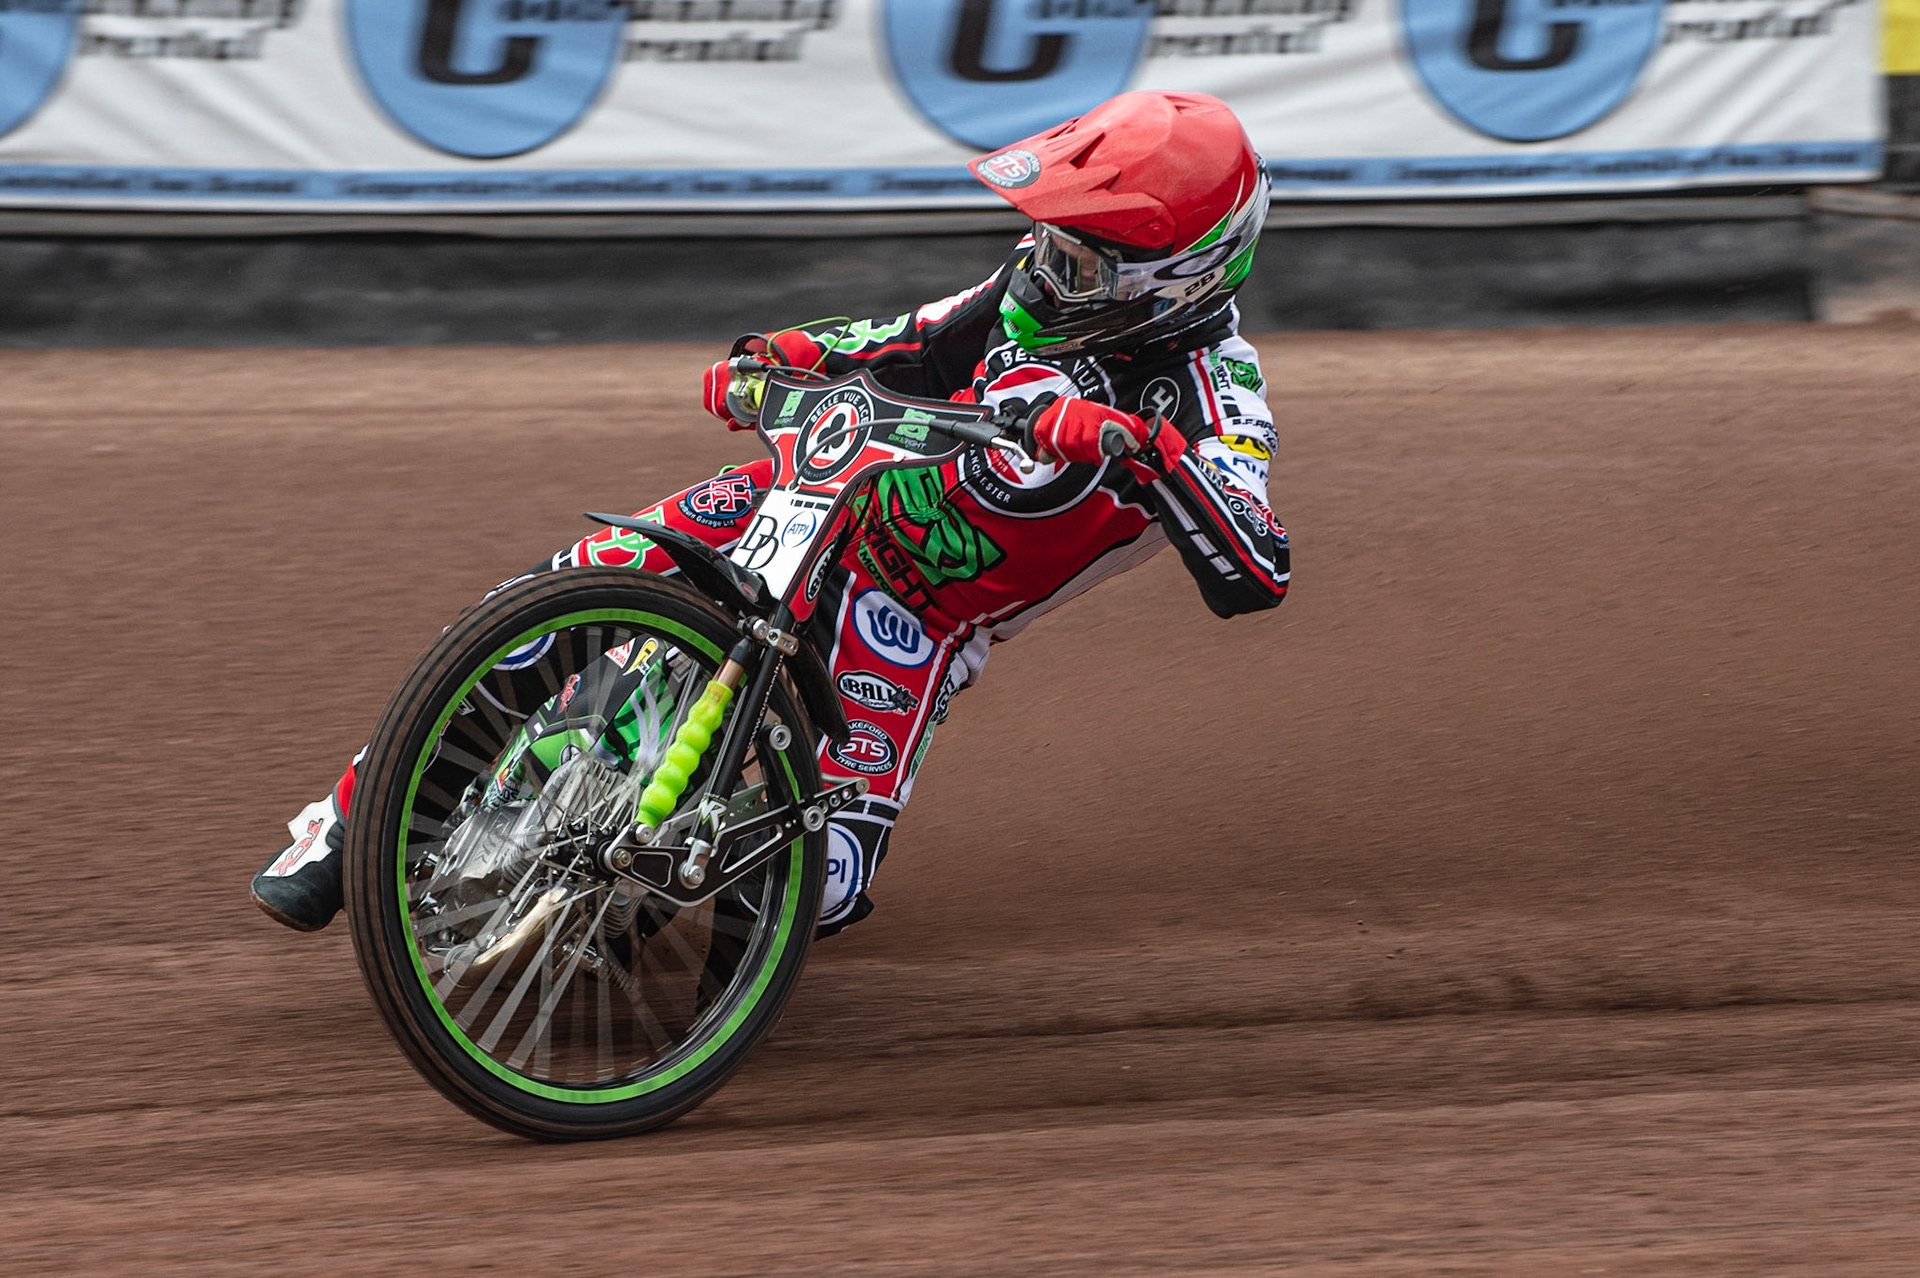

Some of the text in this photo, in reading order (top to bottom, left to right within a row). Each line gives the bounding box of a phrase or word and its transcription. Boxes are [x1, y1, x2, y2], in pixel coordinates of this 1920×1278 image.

[810, 391, 870, 431] BELLE VUE ACE
[970, 443, 1011, 503] ANCHESTER
[695, 515, 722, 528] Garage
[787, 522, 810, 537] ATPI
[835, 756, 893, 773] TYRE SERVICES
[824, 857, 847, 884] PI
